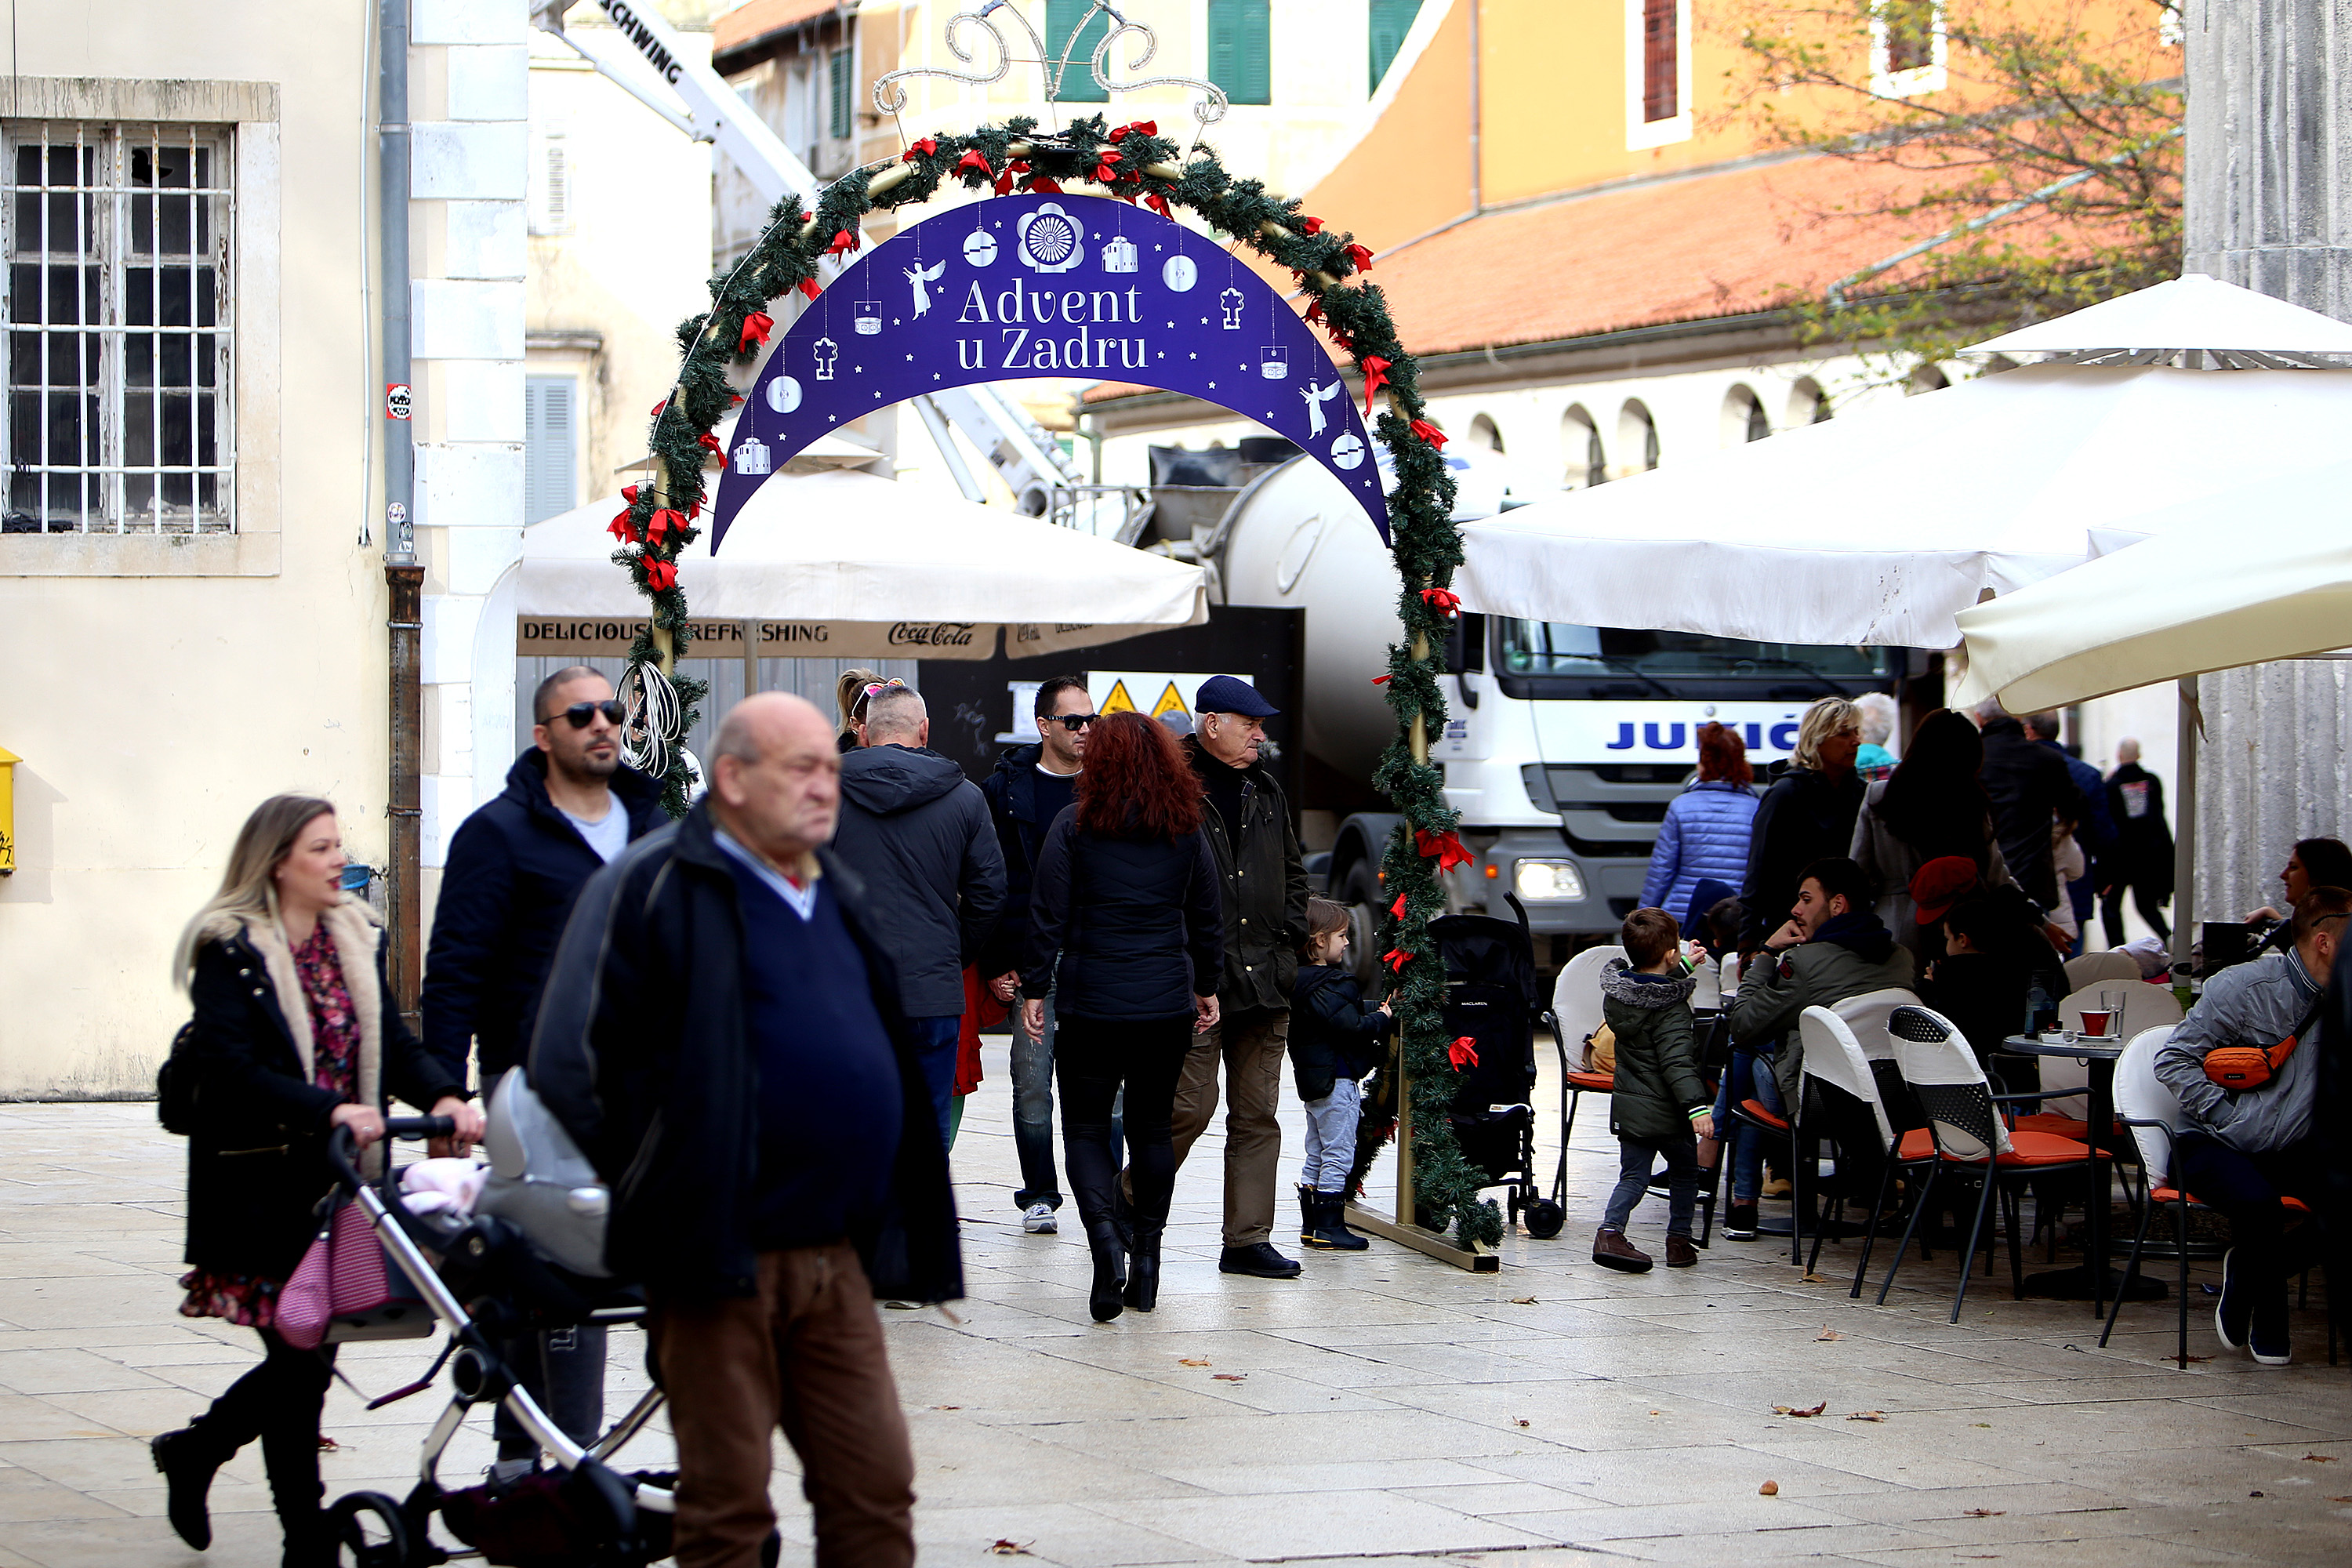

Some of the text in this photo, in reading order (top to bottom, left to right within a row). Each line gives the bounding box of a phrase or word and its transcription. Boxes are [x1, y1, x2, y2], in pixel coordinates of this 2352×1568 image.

[956, 278, 1143, 324] Advent
[956, 325, 1149, 370] u Zadru
[689, 623, 828, 641] REFRSHING
[887, 621, 975, 645] Coca-Cola
